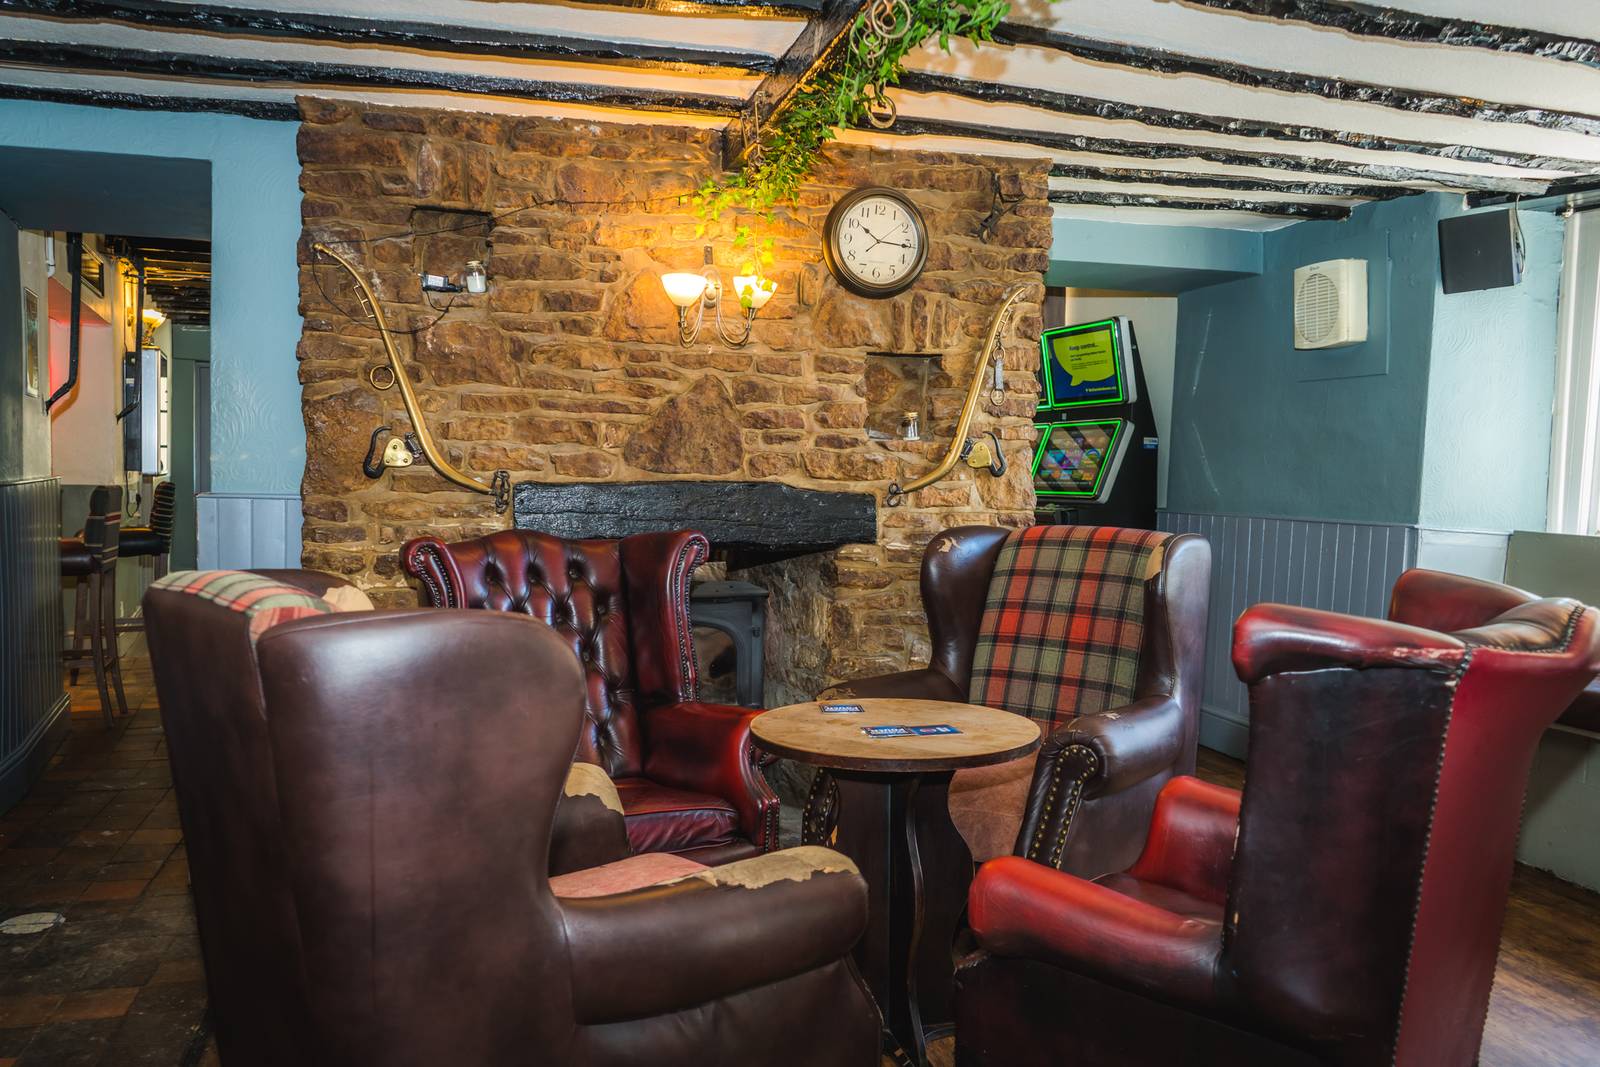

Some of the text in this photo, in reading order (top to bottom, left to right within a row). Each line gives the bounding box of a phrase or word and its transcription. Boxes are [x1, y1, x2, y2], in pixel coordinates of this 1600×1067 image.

[861, 207, 870, 218] 11
[874, 204, 886, 216] 12
[893, 210, 897, 221] 1
[848, 218, 860, 229] 10
[901, 223, 909, 234] 2
[844, 233, 853, 244] 9
[847, 249, 856, 261] 8
[858, 263, 867, 274] 7
[871, 267, 881, 279] 6
[888, 265, 896, 276] 5
